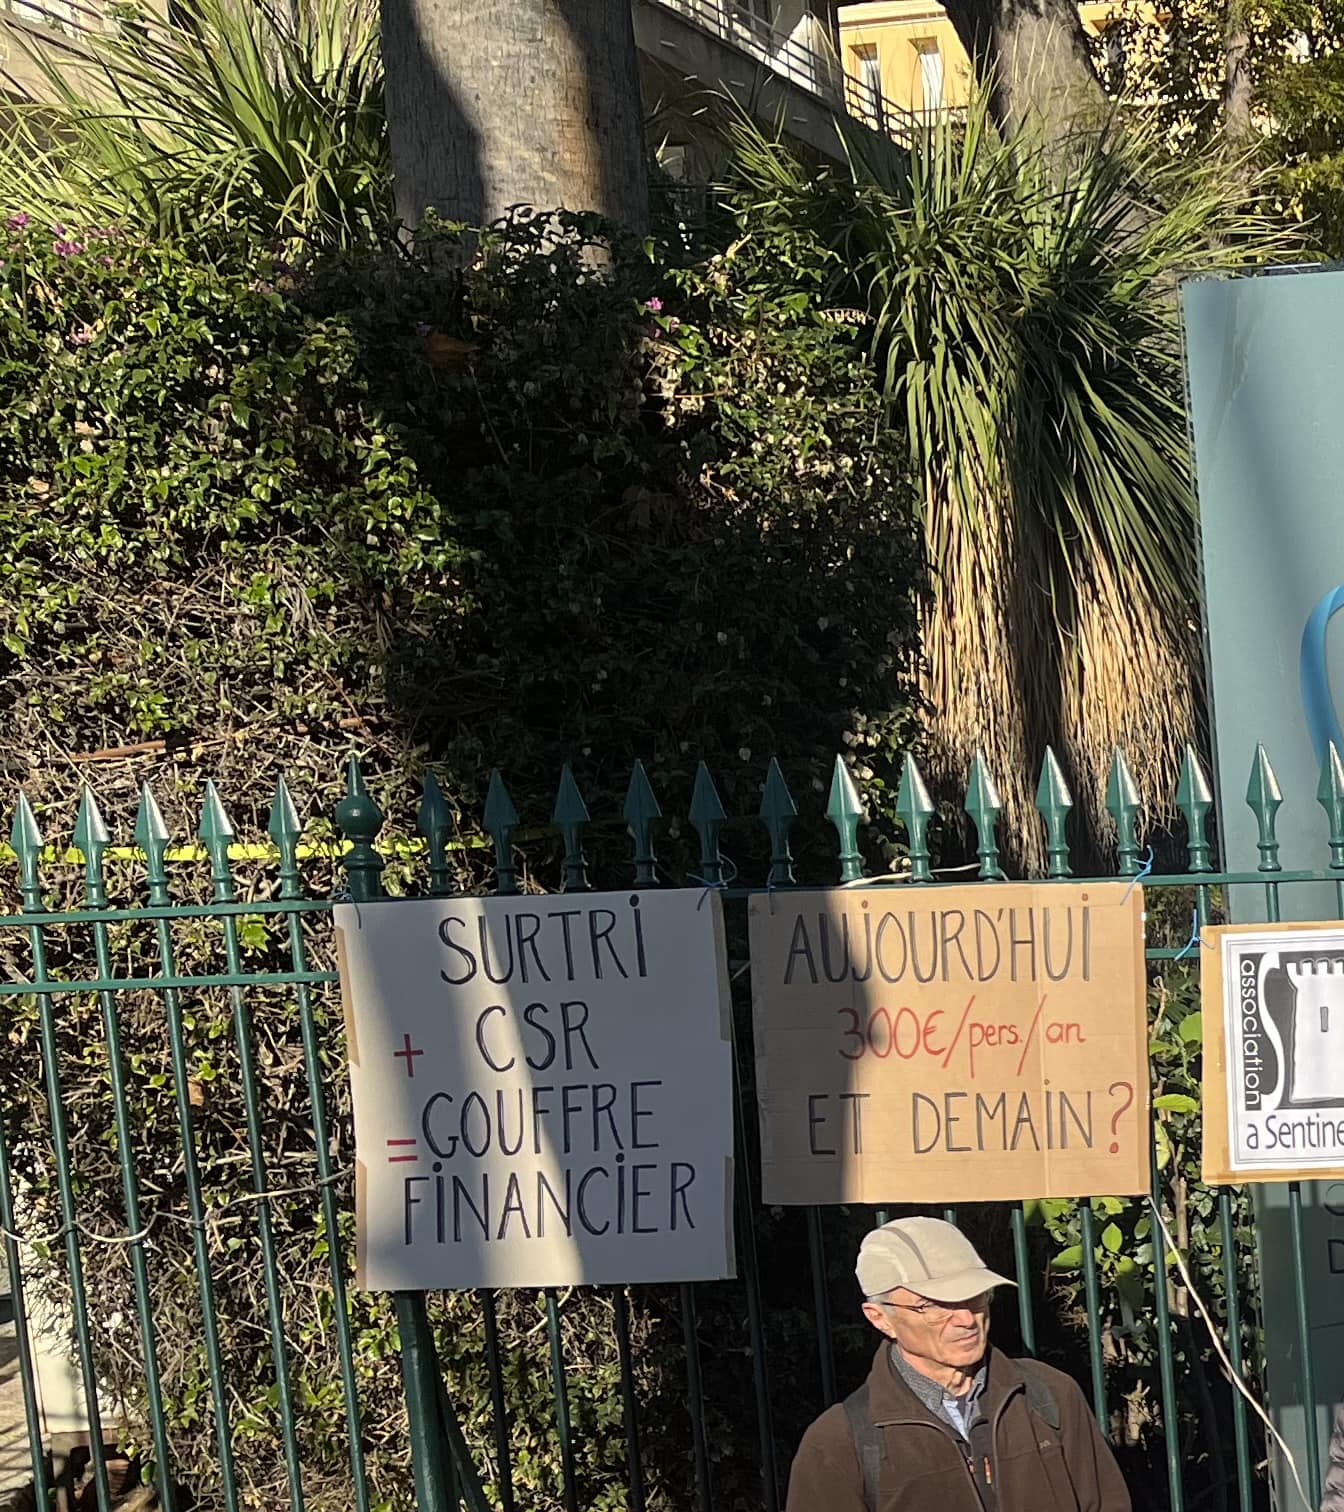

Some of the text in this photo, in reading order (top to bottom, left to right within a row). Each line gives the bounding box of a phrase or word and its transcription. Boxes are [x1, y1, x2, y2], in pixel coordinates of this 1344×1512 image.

[439, 894, 648, 985] SURTRI
[784, 893, 1092, 985] AUJOURD'HUI
[476, 1001, 599, 1073] CSR
[1240, 959, 1264, 1105] association
[808, 1091, 870, 1155] ET
[1246, 1123, 1258, 1149] a
[403, 1152, 696, 1245] FINANCIER
